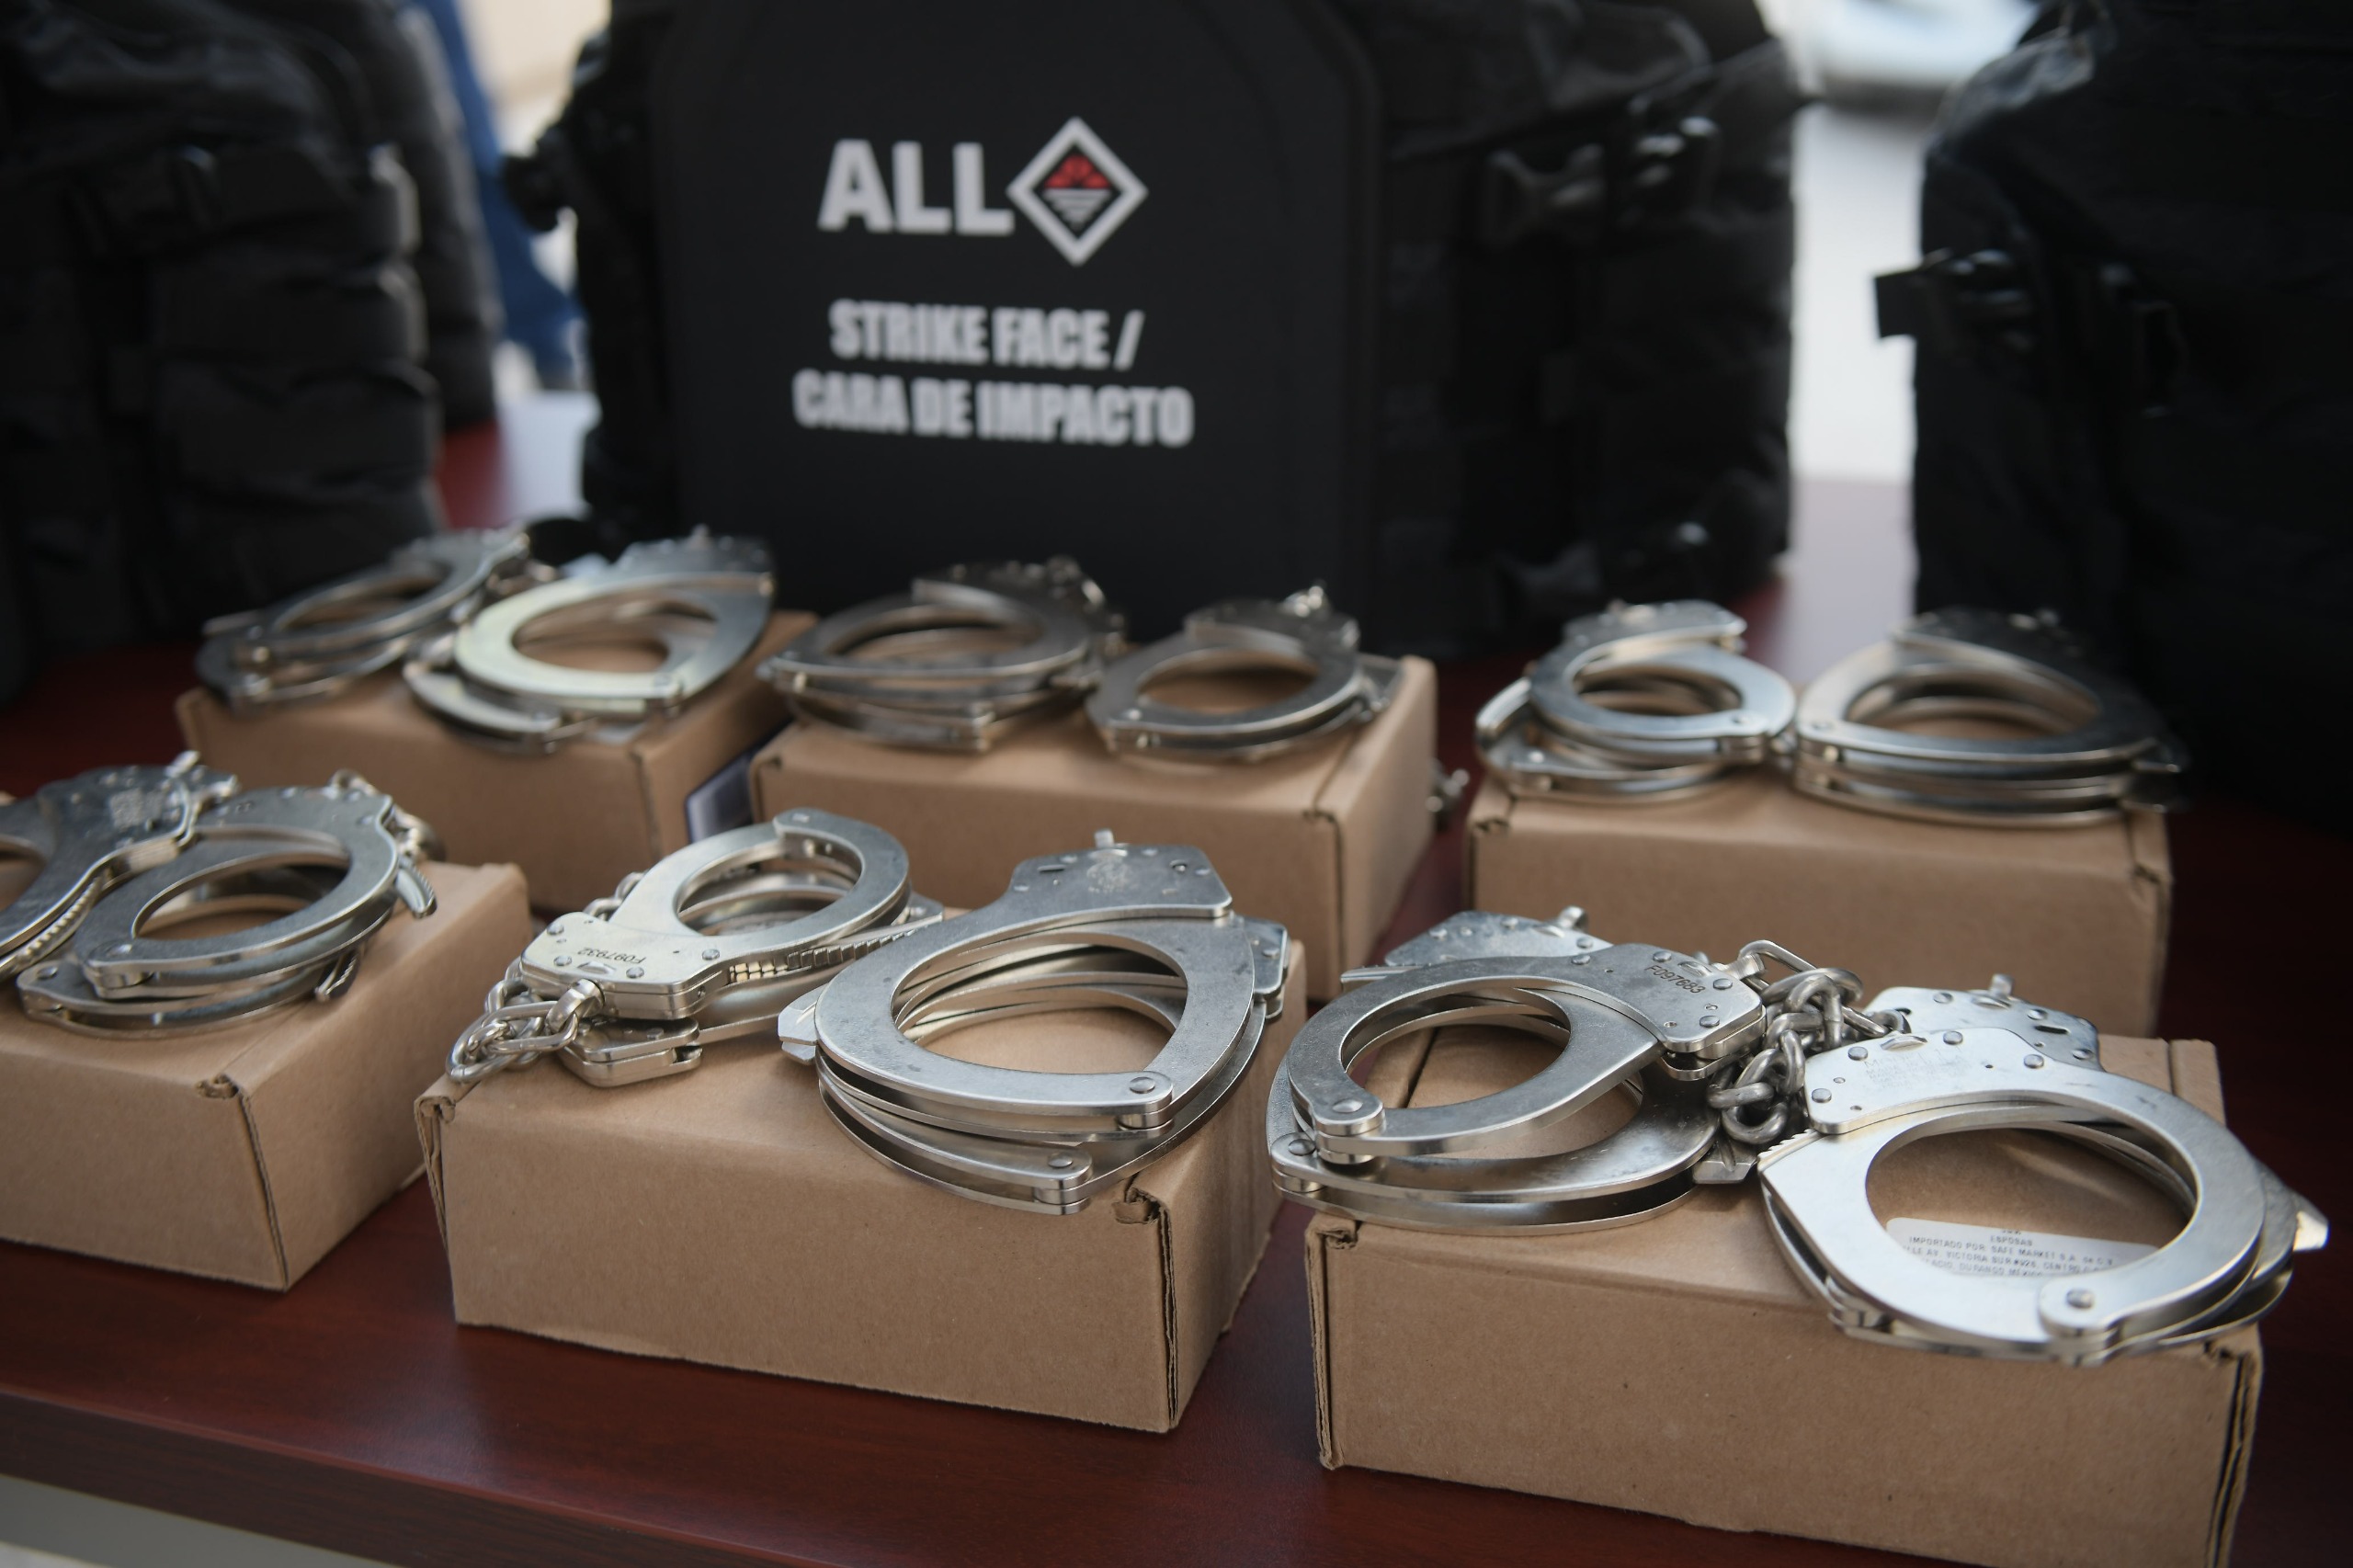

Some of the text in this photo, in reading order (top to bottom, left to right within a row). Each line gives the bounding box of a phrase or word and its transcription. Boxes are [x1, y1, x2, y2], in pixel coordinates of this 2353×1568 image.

[818, 139, 1014, 235] ALL
[829, 299, 1144, 370] STRIKE FACE /
[792, 369, 1194, 448] CARA DE IMPACTO
[1644, 965, 1706, 994] F097683
[1910, 1236, 1962, 1249] IMPORTADO
